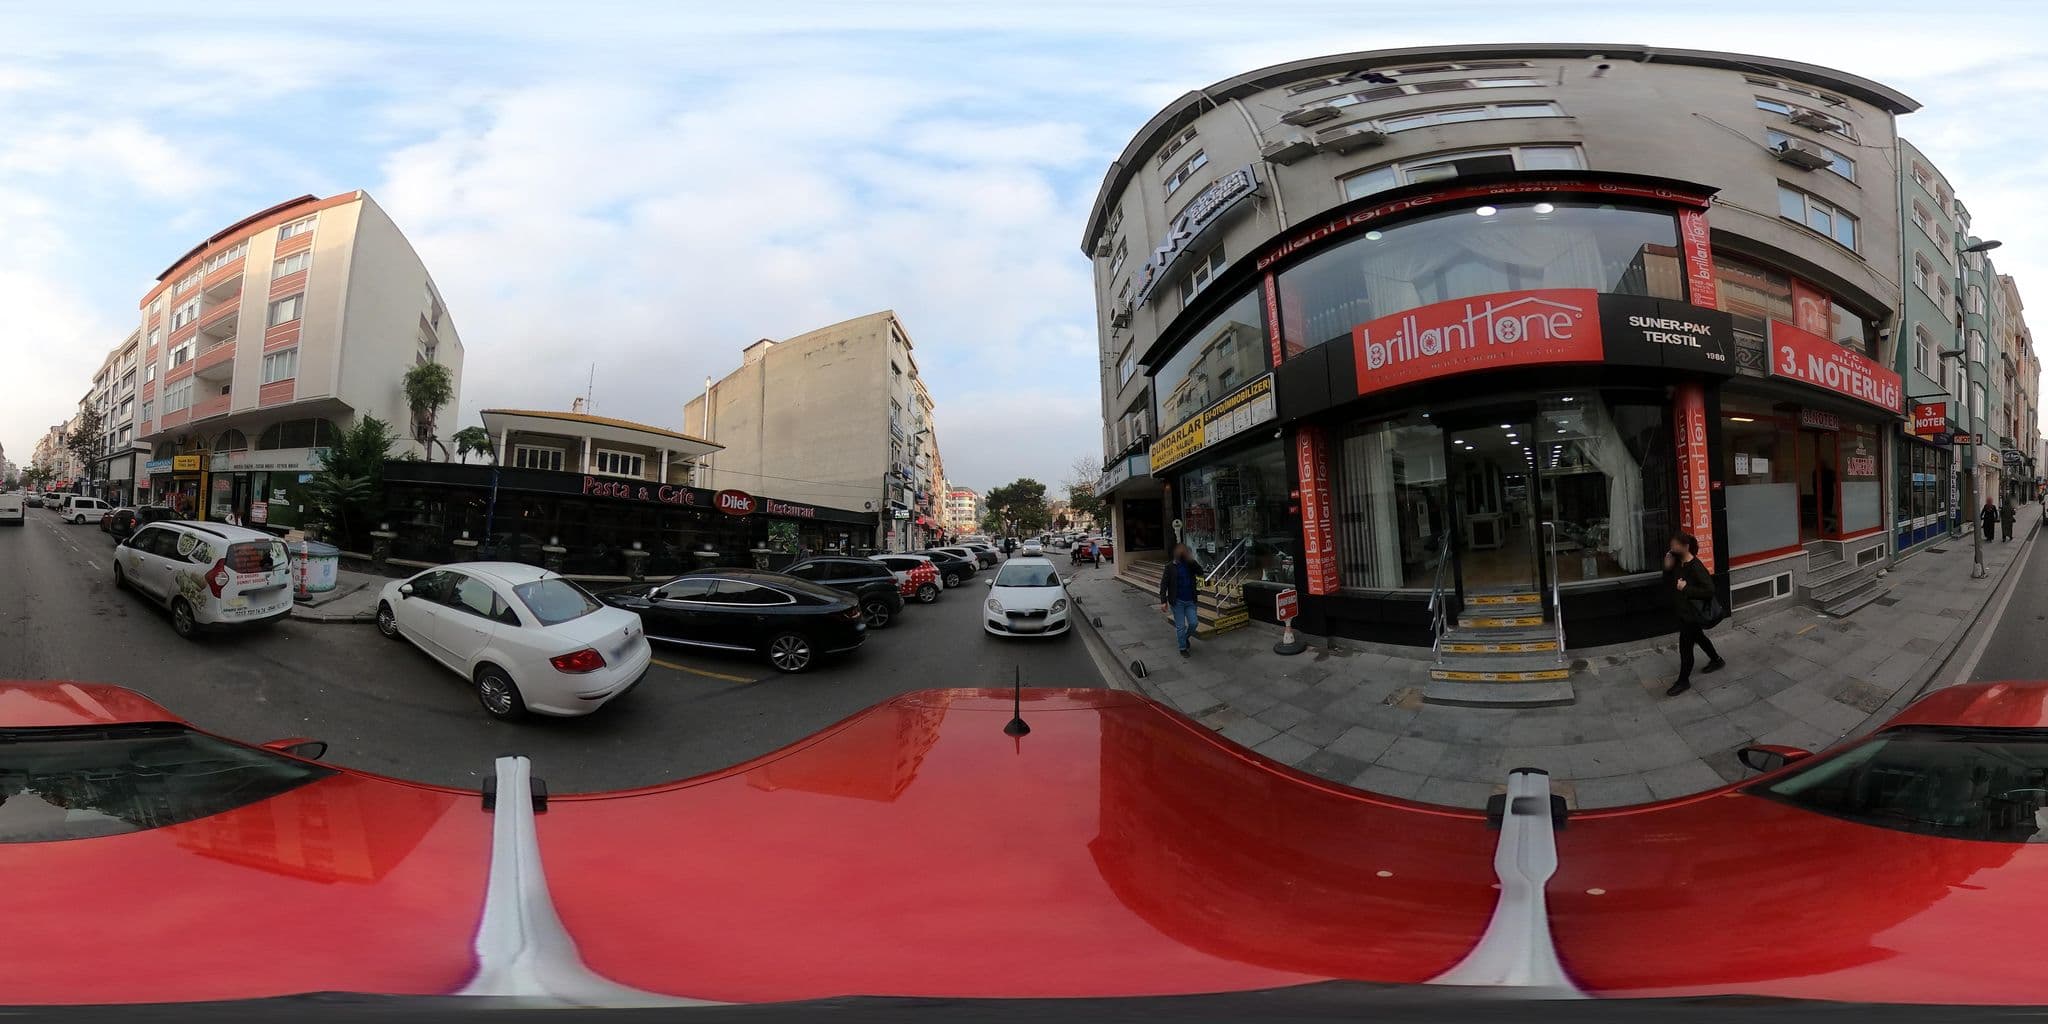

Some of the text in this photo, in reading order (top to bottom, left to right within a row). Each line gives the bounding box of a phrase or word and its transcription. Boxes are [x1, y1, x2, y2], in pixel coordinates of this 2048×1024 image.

[1628, 316, 1711, 336] SUNER-PAK
[1642, 331, 1701, 348] TEKSTİL
[1843, 350, 1863, 364] T.C.
[1781, 345, 1899, 410] 3. NOTERLİĞİ
[1925, 406, 1936, 416] 3.
[1916, 417, 1945, 428] NOTER
[582, 475, 694, 505] Pasta & Cafe
[721, 494, 751, 511] Dilek
[766, 499, 816, 519] Restaurant
